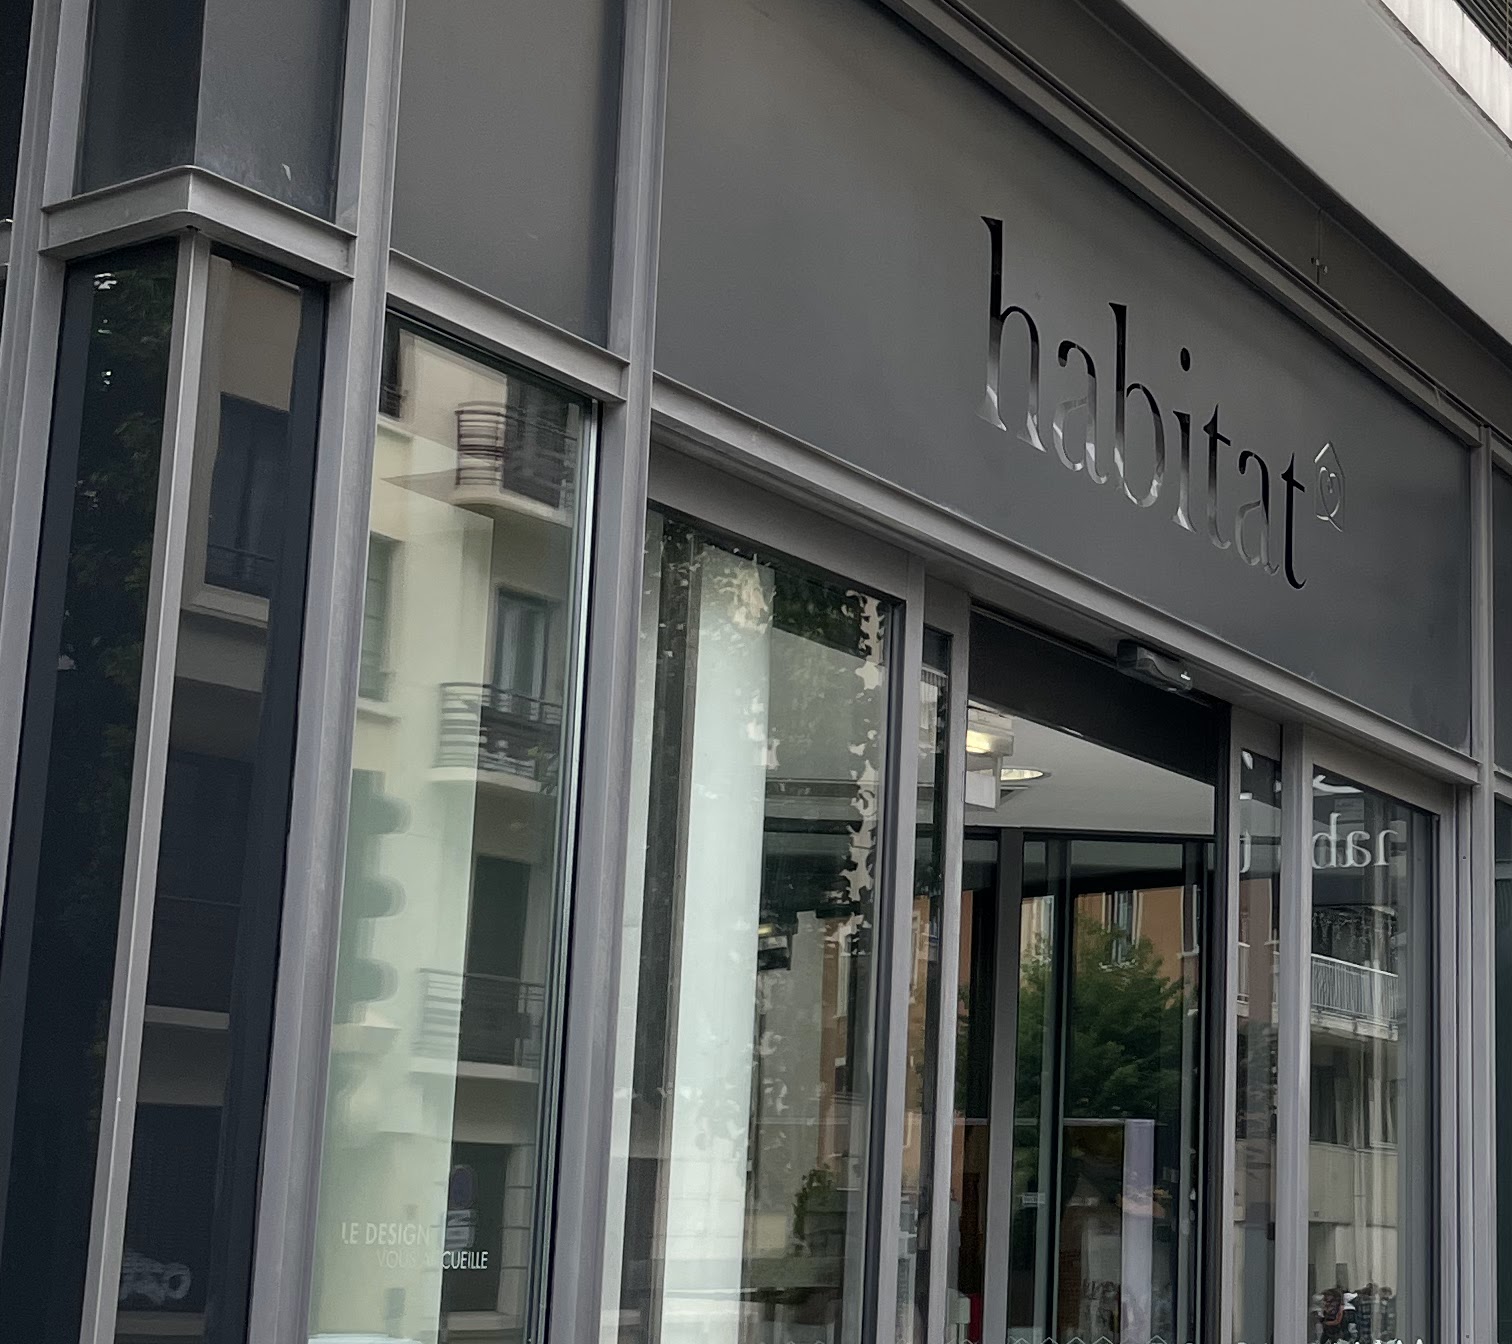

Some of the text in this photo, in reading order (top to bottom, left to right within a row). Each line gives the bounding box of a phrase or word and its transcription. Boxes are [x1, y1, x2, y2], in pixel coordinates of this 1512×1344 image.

[976, 215, 1307, 589] habitat
[341, 1222, 431, 1245] LE DESIGN
